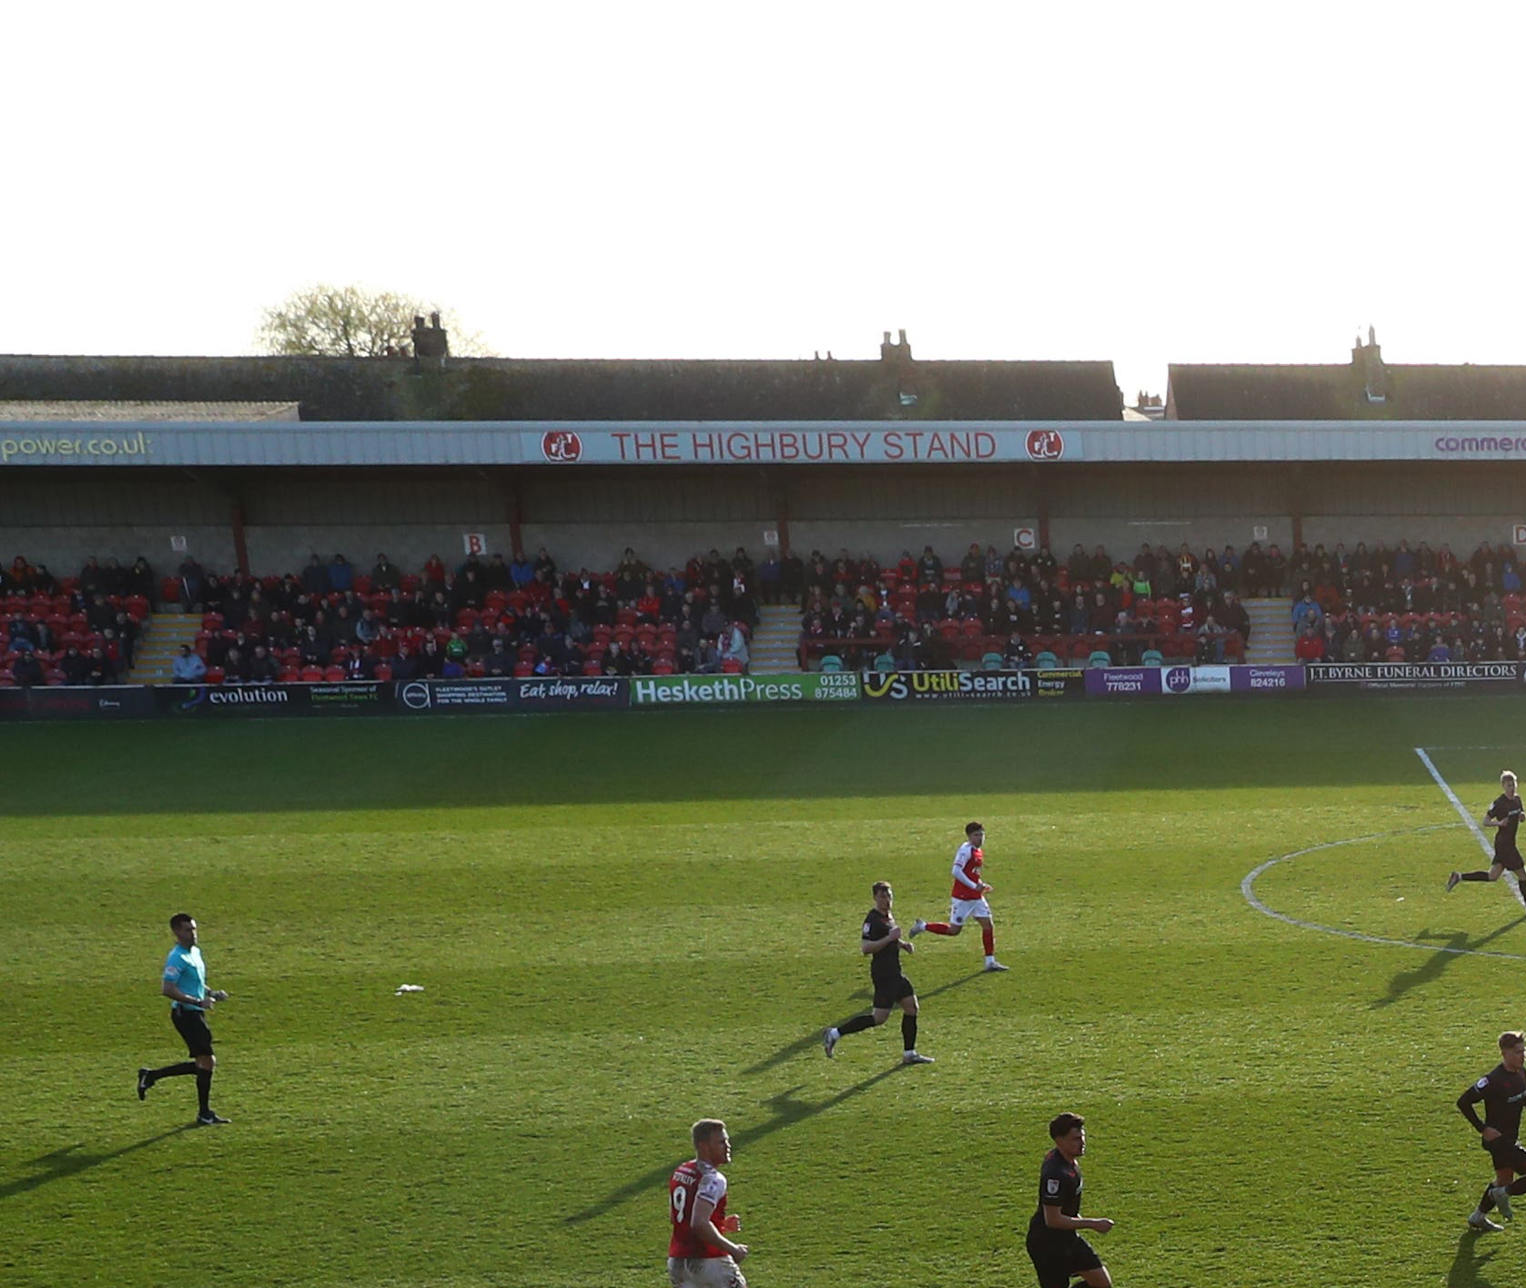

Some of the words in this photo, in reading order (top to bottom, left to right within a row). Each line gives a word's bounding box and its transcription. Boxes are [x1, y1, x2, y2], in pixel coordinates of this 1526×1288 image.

[611, 433, 681, 460] THE
[692, 432, 871, 460] HIGHBURY
[883, 432, 997, 459] STAND
[469, 534, 482, 553] B
[1016, 529, 1034, 548] C
[1103, 673, 1144, 682] Fleetwood
[1249, 669, 1286, 679] Cleveleys
[1377, 666, 1438, 678] FUNERAL
[1440, 665, 1517, 677] DIRECTORS
[820, 675, 856, 687] 01253
[912, 671, 1031, 692] UtiliSearch
[1037, 679, 1065, 689] Energy
[1106, 681, 1142, 691] 778231
[1250, 678, 1286, 688] 824216
[209, 687, 288, 703] evolution
[520, 683, 546, 699] Eat,
[549, 680, 579, 700] shop,
[580, 682, 619, 696] relax!
[636, 678, 803, 702] HeskethPress
[815, 686, 857, 699] 875484
[673, 1186, 687, 1224] 9
